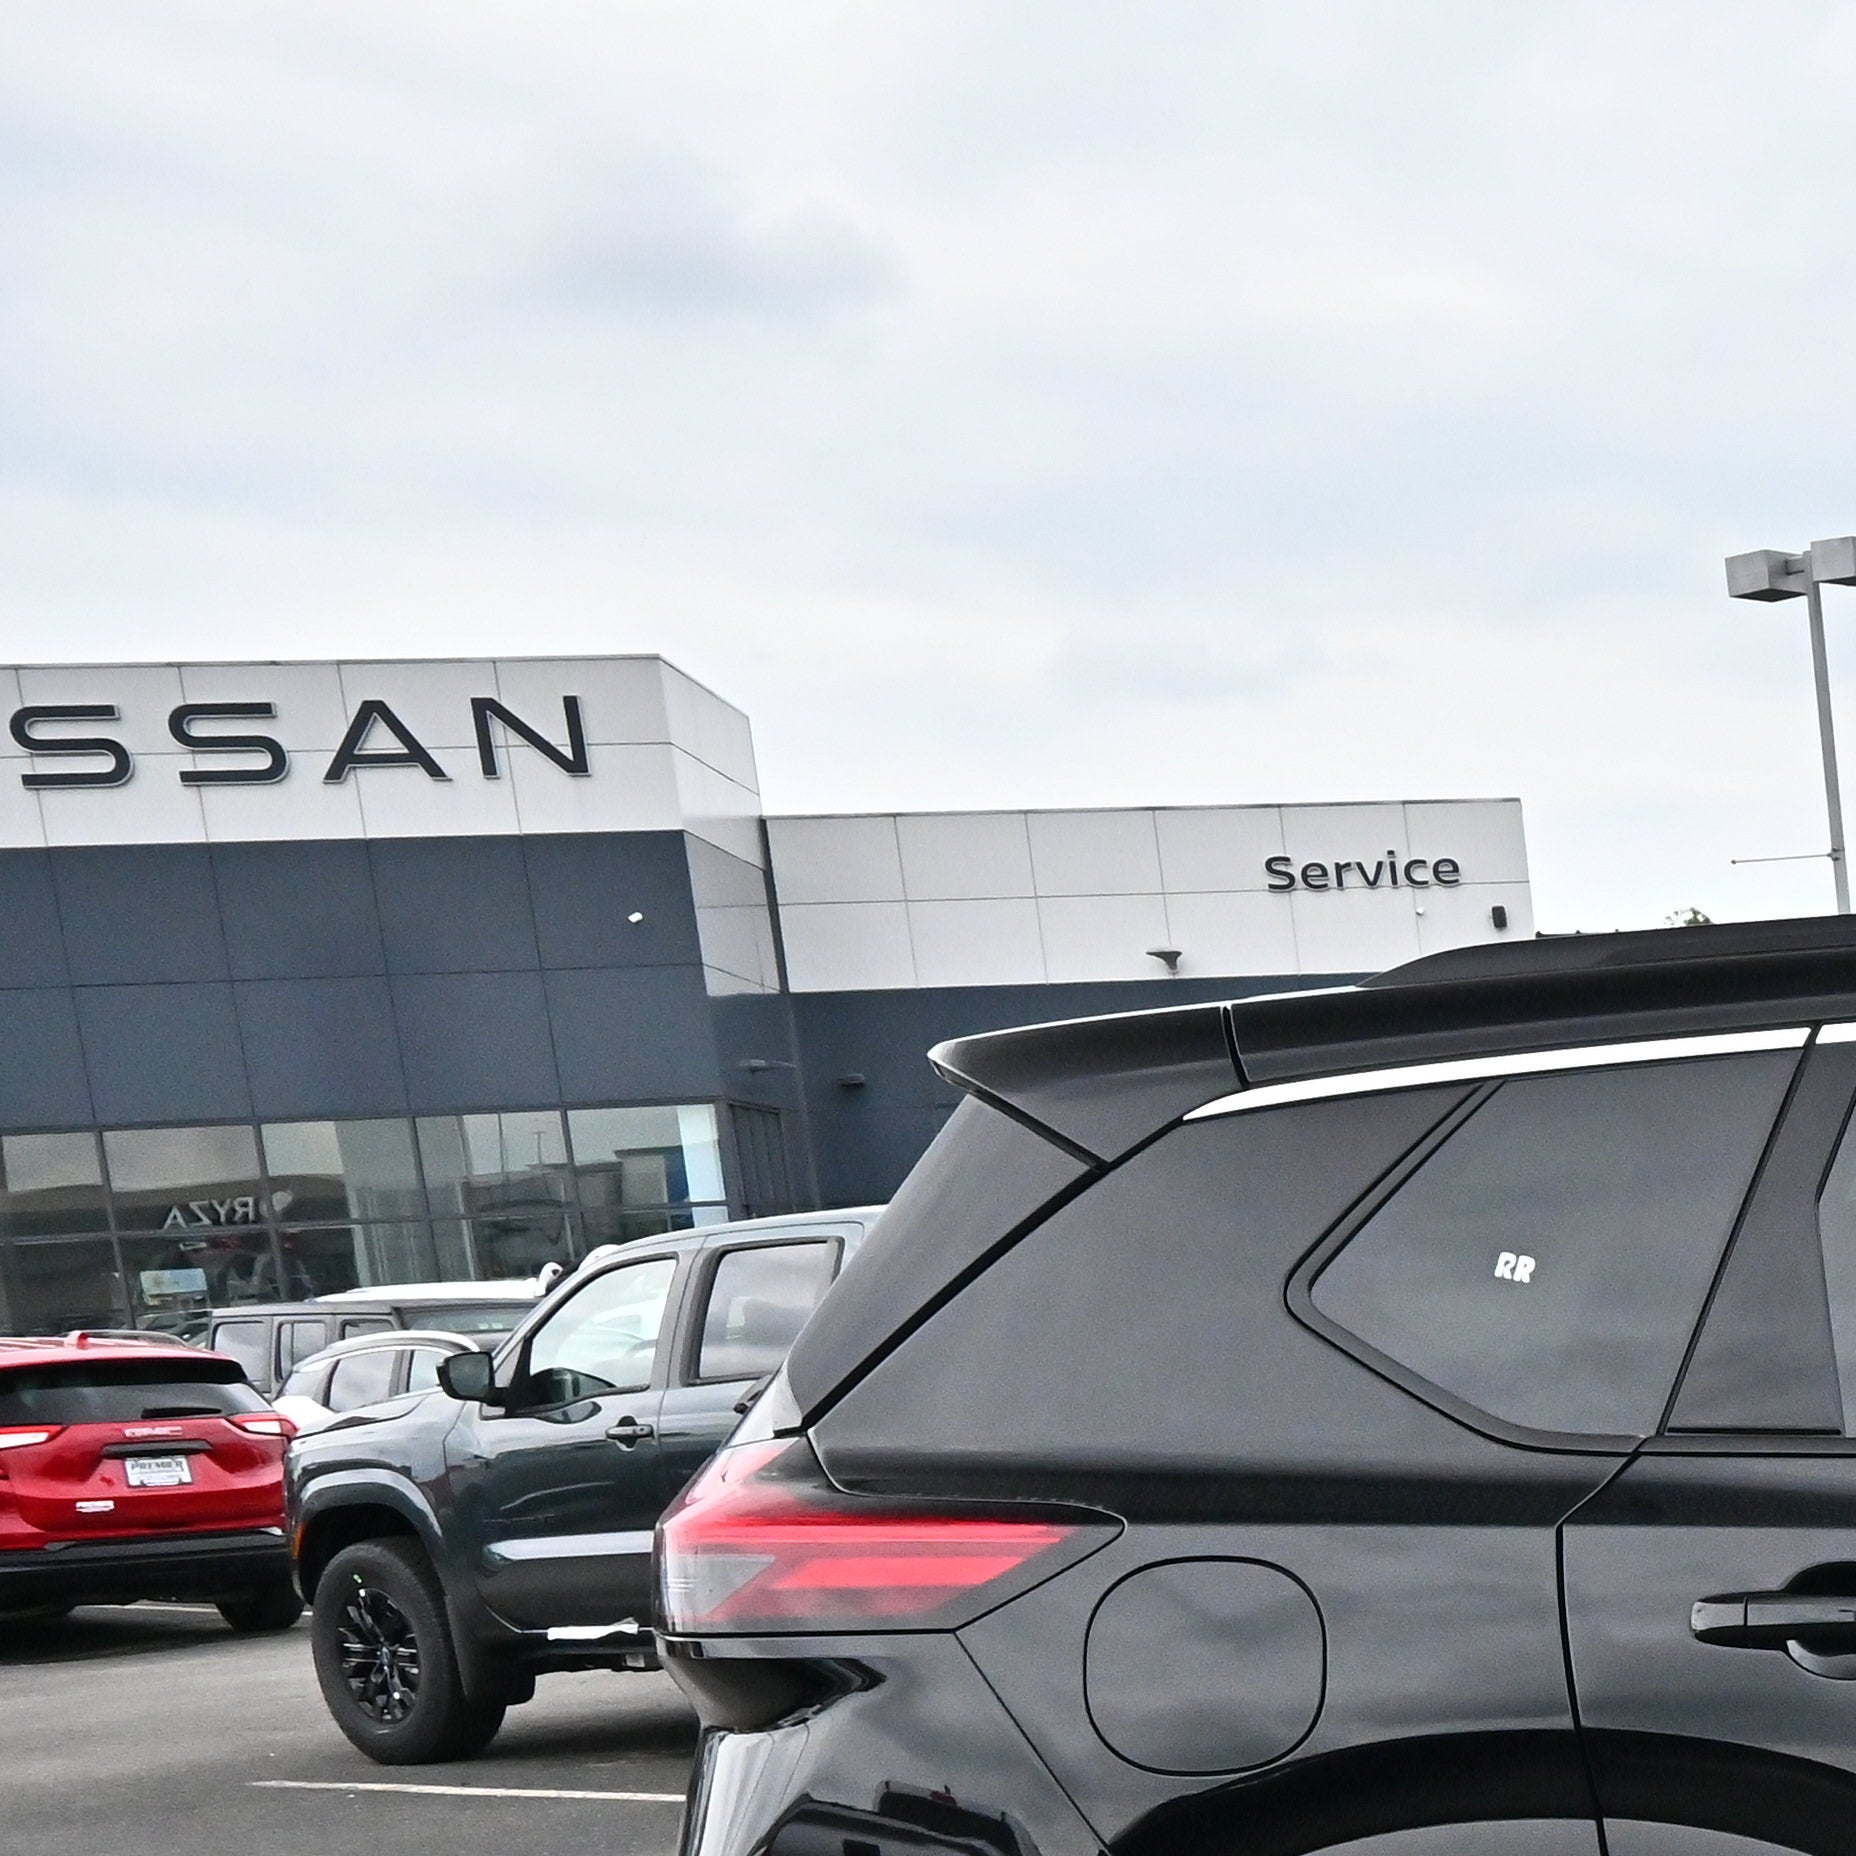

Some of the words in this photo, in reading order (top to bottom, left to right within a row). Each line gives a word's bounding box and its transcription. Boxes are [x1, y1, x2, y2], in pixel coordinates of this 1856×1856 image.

[1263, 849, 1463, 893] Service
[1493, 1251, 1537, 1284] RR
[124, 1425, 183, 1439] GMC
[130, 1460, 184, 1472] PREMIER
